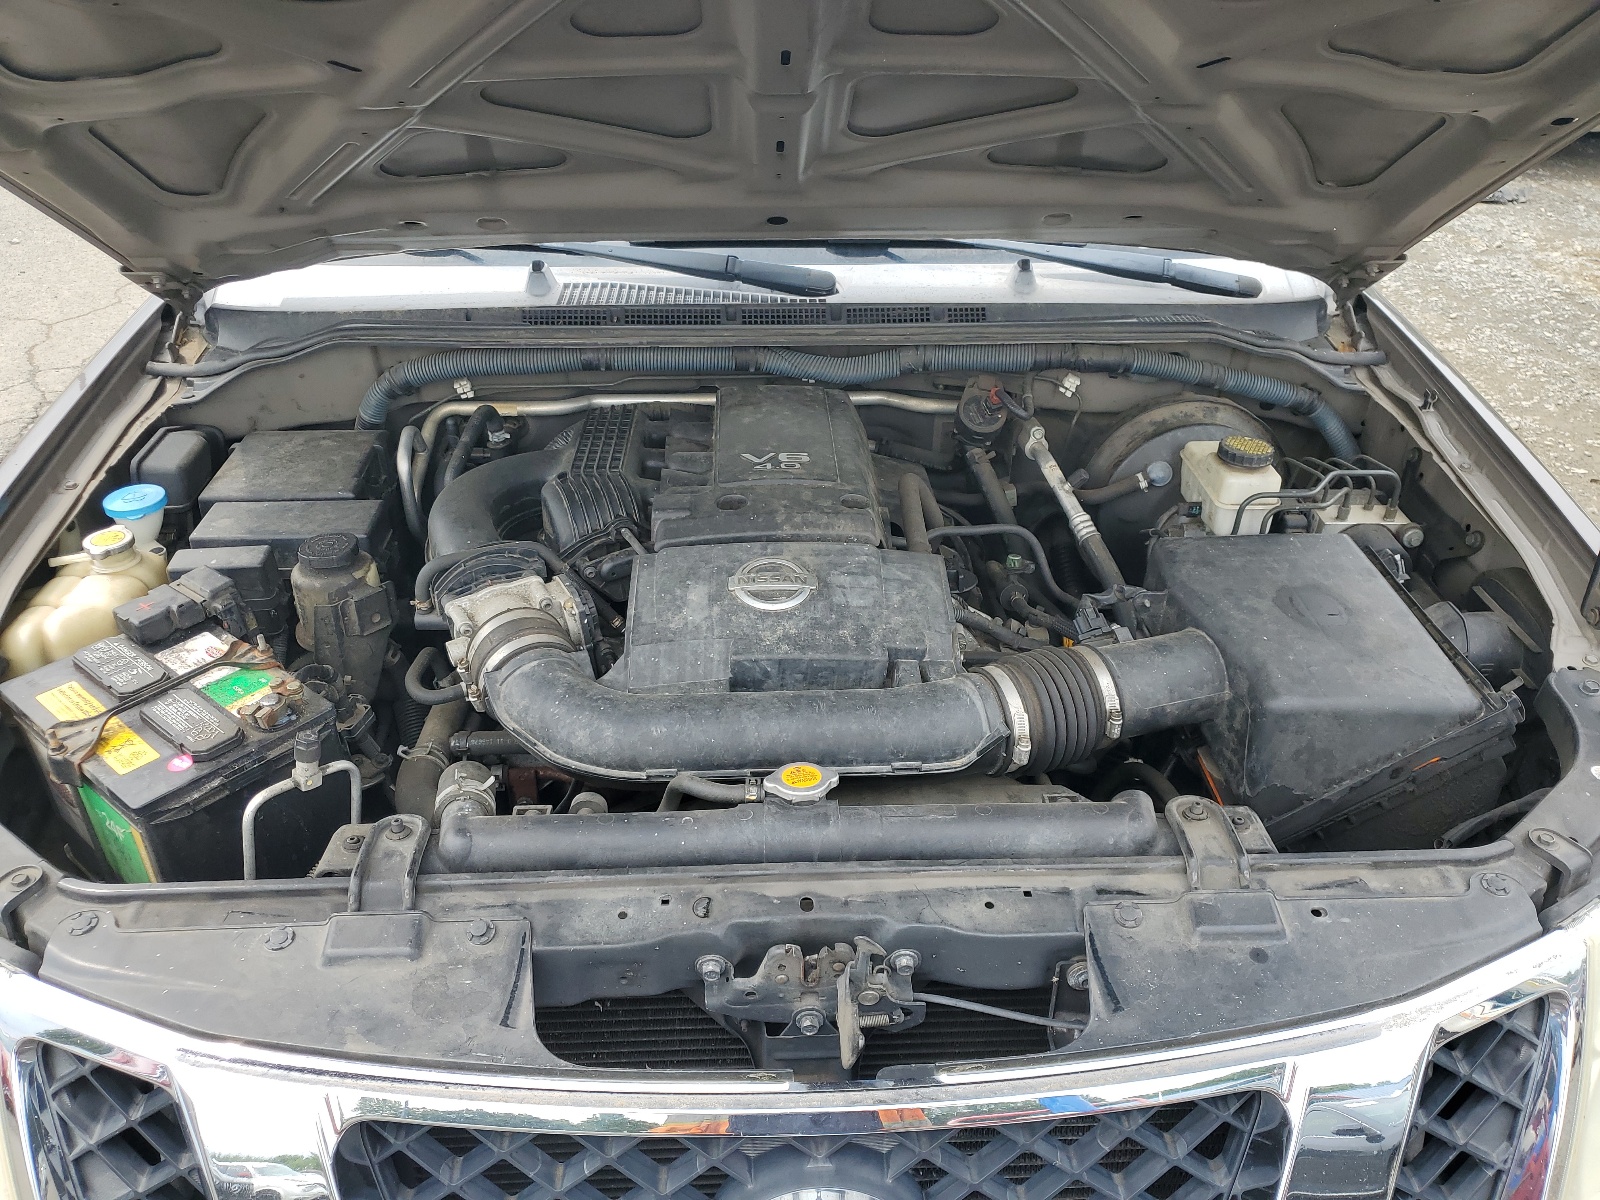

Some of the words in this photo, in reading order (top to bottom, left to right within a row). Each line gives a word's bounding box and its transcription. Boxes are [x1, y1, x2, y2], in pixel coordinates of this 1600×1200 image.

[740, 452, 811, 463] V6
[753, 462, 802, 470] 4.0
[737, 574, 808, 584] NISSAN
